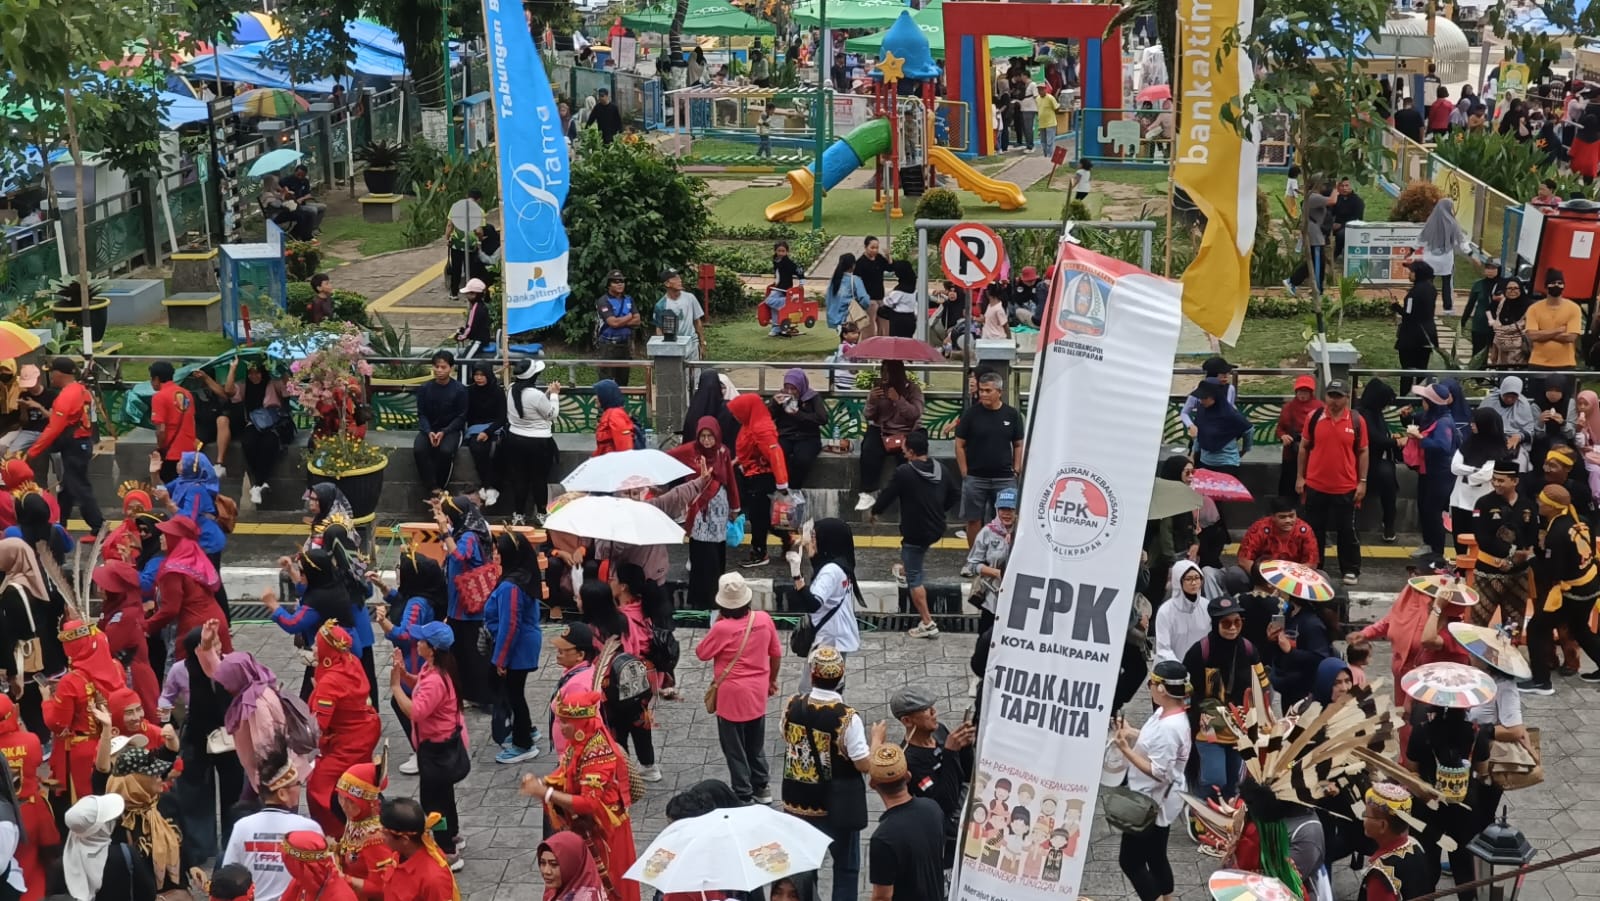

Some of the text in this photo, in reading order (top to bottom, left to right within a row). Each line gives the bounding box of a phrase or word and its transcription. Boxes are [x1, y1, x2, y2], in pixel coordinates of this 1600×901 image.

[494, 19, 514, 119] Tabungan
[1037, 489, 1051, 520] FORUM
[1090, 473, 1118, 527] KEBANGSAAN
[1053, 500, 1089, 519] FPK
[1006, 572, 1120, 645] FPK
[1000, 635, 1110, 663] KOTA BALIKPAPAN
[994, 664, 1104, 713] TIDAK AKU,
[1000, 693, 1090, 738] TAPI KITA
